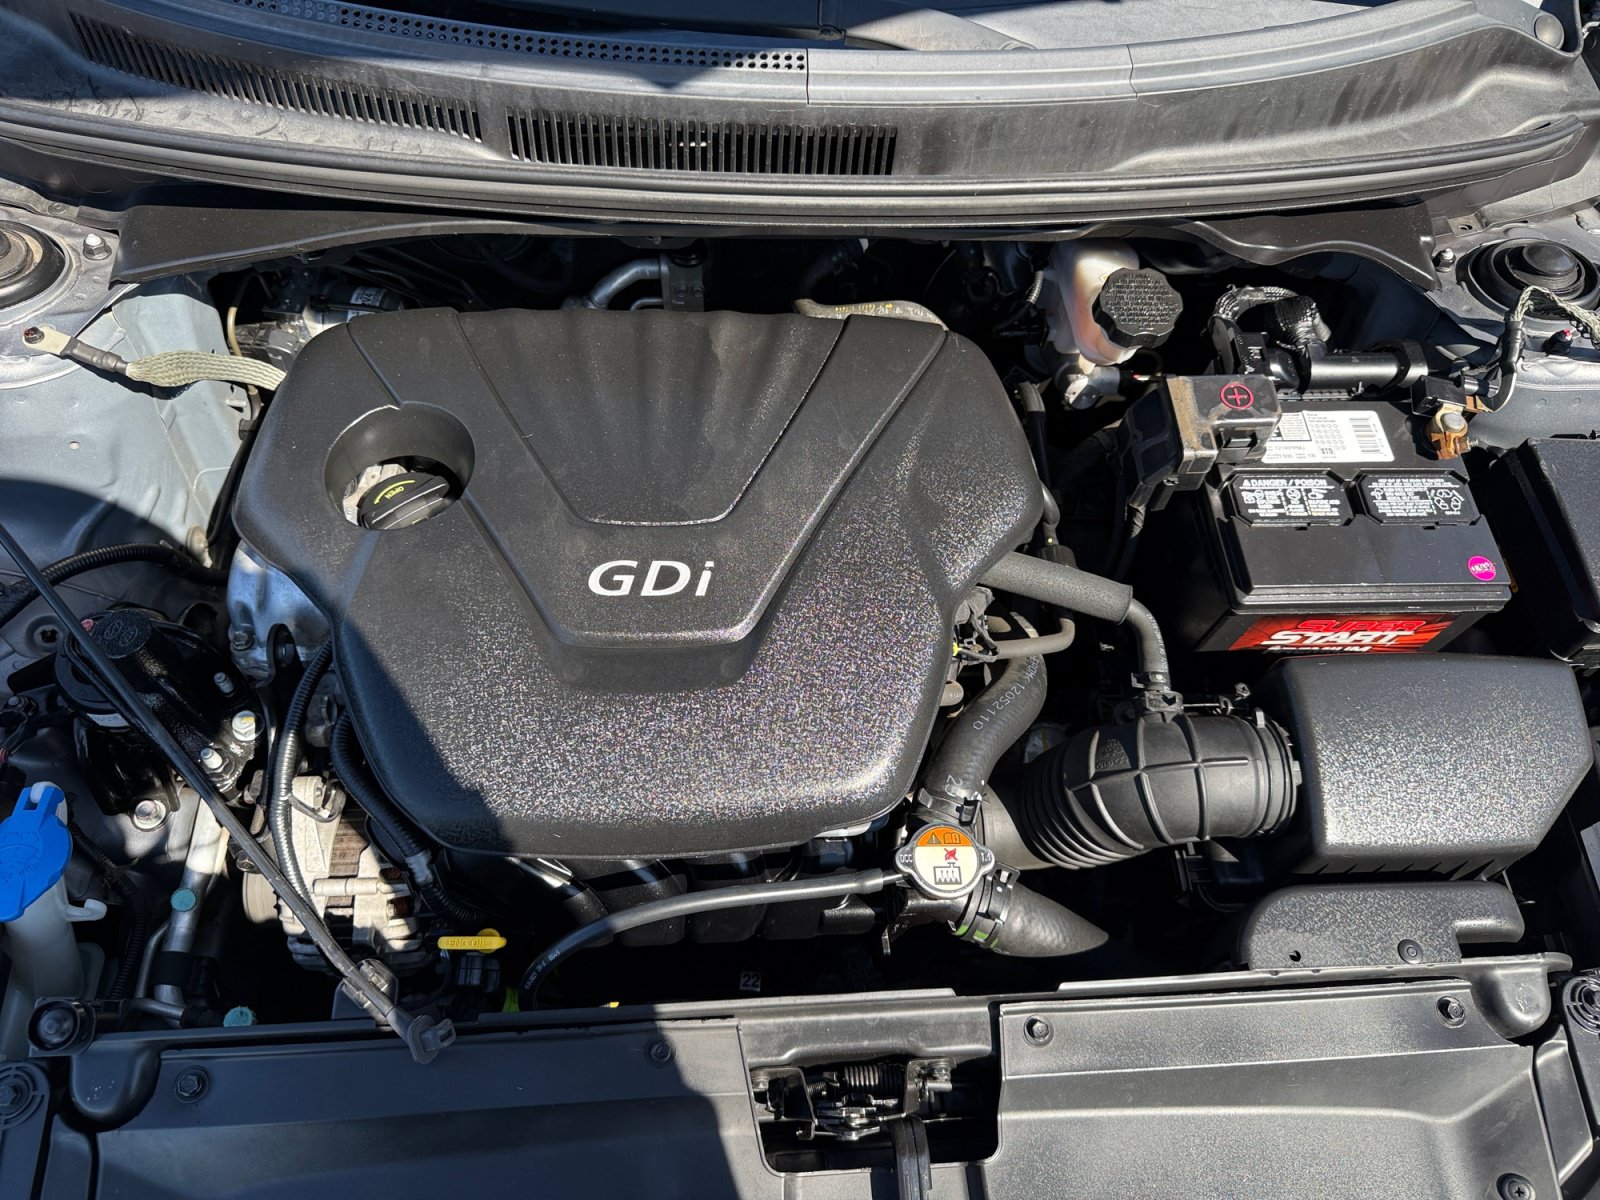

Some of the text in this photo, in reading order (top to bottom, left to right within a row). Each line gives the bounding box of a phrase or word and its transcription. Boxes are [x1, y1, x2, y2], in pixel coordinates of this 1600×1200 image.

[1250, 479, 1287, 487] DANGER
[1294, 479, 1328, 487] POISON
[384, 486, 405, 500] OPEN
[588, 560, 715, 597] GDi
[1296, 619, 1426, 632] SUPER
[1260, 630, 1415, 647] START
[972, 682, 1025, 730] 12052110
[449, 938, 488, 948] ENG OIL
[742, 973, 760, 989] 22
